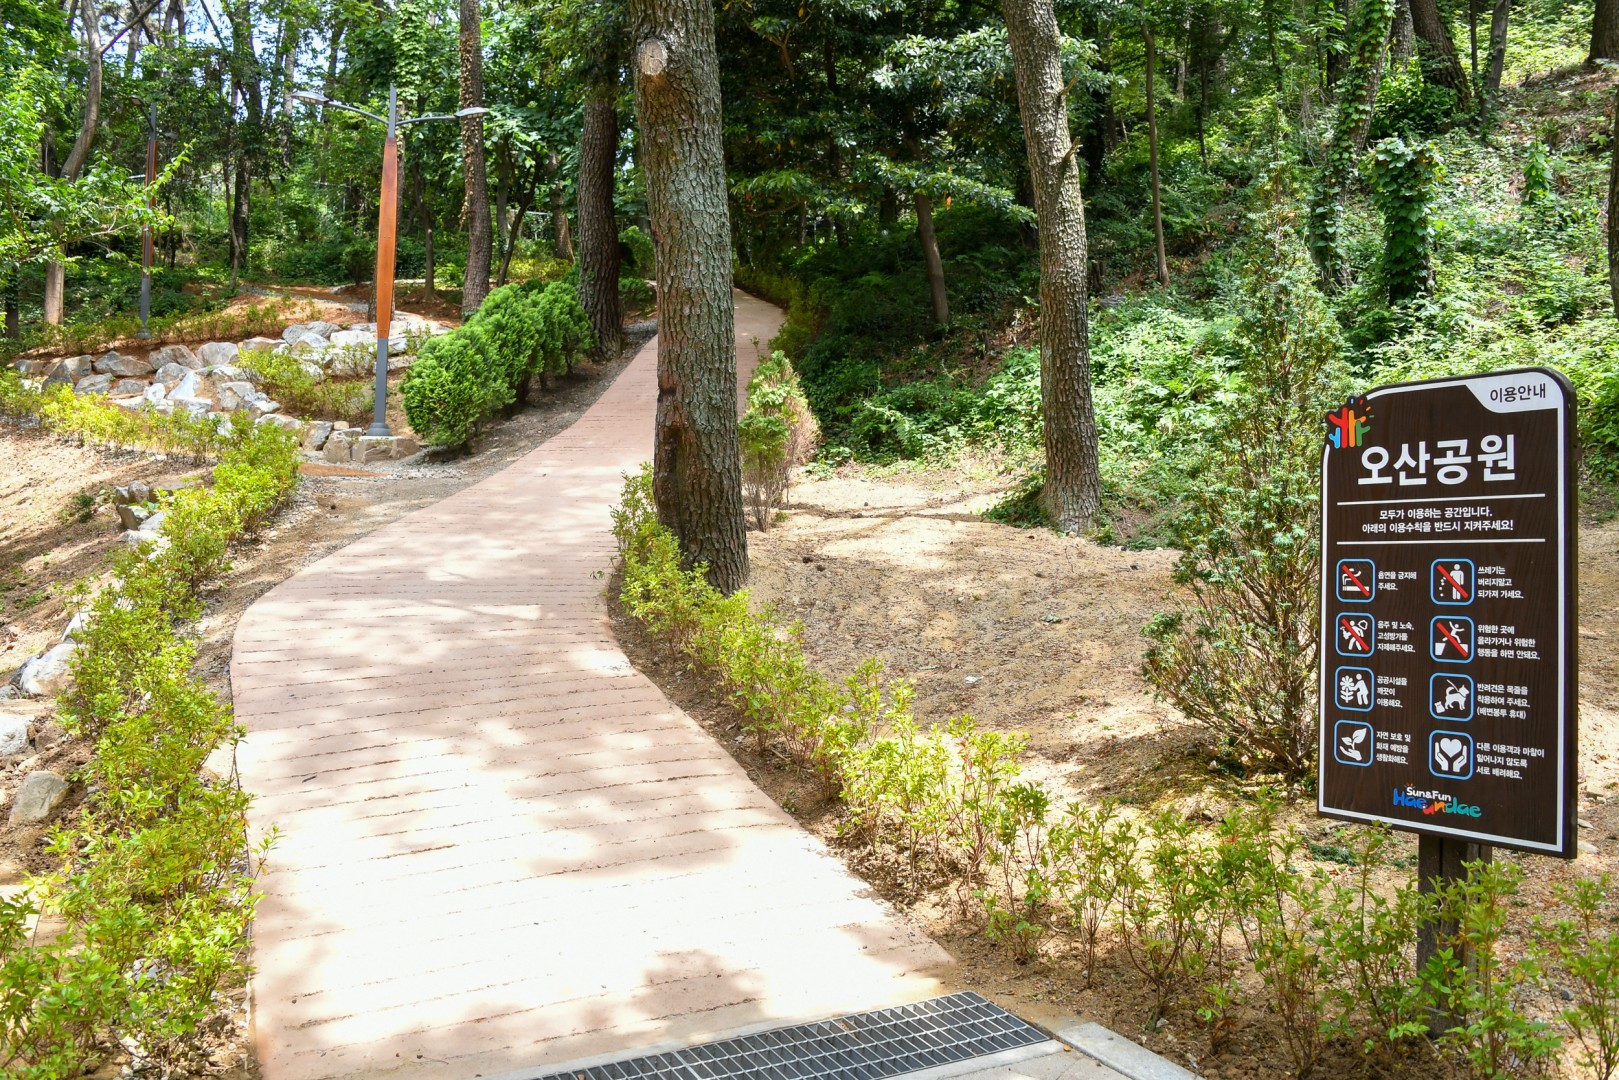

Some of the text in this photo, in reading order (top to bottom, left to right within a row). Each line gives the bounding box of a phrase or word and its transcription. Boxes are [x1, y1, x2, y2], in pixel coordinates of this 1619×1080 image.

[1490, 383, 1546, 402] 이용안내
[1358, 434, 1515, 485] 오산공원
[1379, 506, 1492, 520] 모두가 이용하는 공간입니다.
[1362, 520, 1513, 533] 아래의 이용수칙을 반드시 지켜주세요!
[1378, 571, 1416, 580] 흡연을 금지해
[1478, 566, 1506, 574] 쓰레기는
[1378, 582, 1398, 590] 주세요.
[1478, 578, 1512, 586] 버리지말고
[1478, 590, 1524, 598] 되가져 가세요.
[1378, 620, 1390, 629] 음주
[1392, 621, 1398, 630] 및
[1478, 624, 1514, 634] 위험한 곳에
[1377, 632, 1408, 641] 고성방가를
[1478, 636, 1536, 648] 올라가거나 위험한
[1377, 643, 1416, 652] 자제해주세요.
[1478, 648, 1498, 658] 행동을
[1500, 650, 1514, 658] 하면
[1377, 687, 1396, 696] 깨끗이
[1477, 683, 1528, 696] 반려견은 목줄을
[1477, 695, 1530, 708] 착용하여 주세요.
[1477, 706, 1526, 720] (배변봉투 휴대)
[1376, 731, 1412, 742] 자연 보호 및
[1376, 742, 1408, 754] 화재 예방을
[1476, 742, 1544, 758] 다른 이용객과 마찰이
[1476, 754, 1528, 768] 일어나지 않도록
[1476, 766, 1522, 780] 서로 배려해요.
[1406, 786, 1452, 802] Sun&Fun
